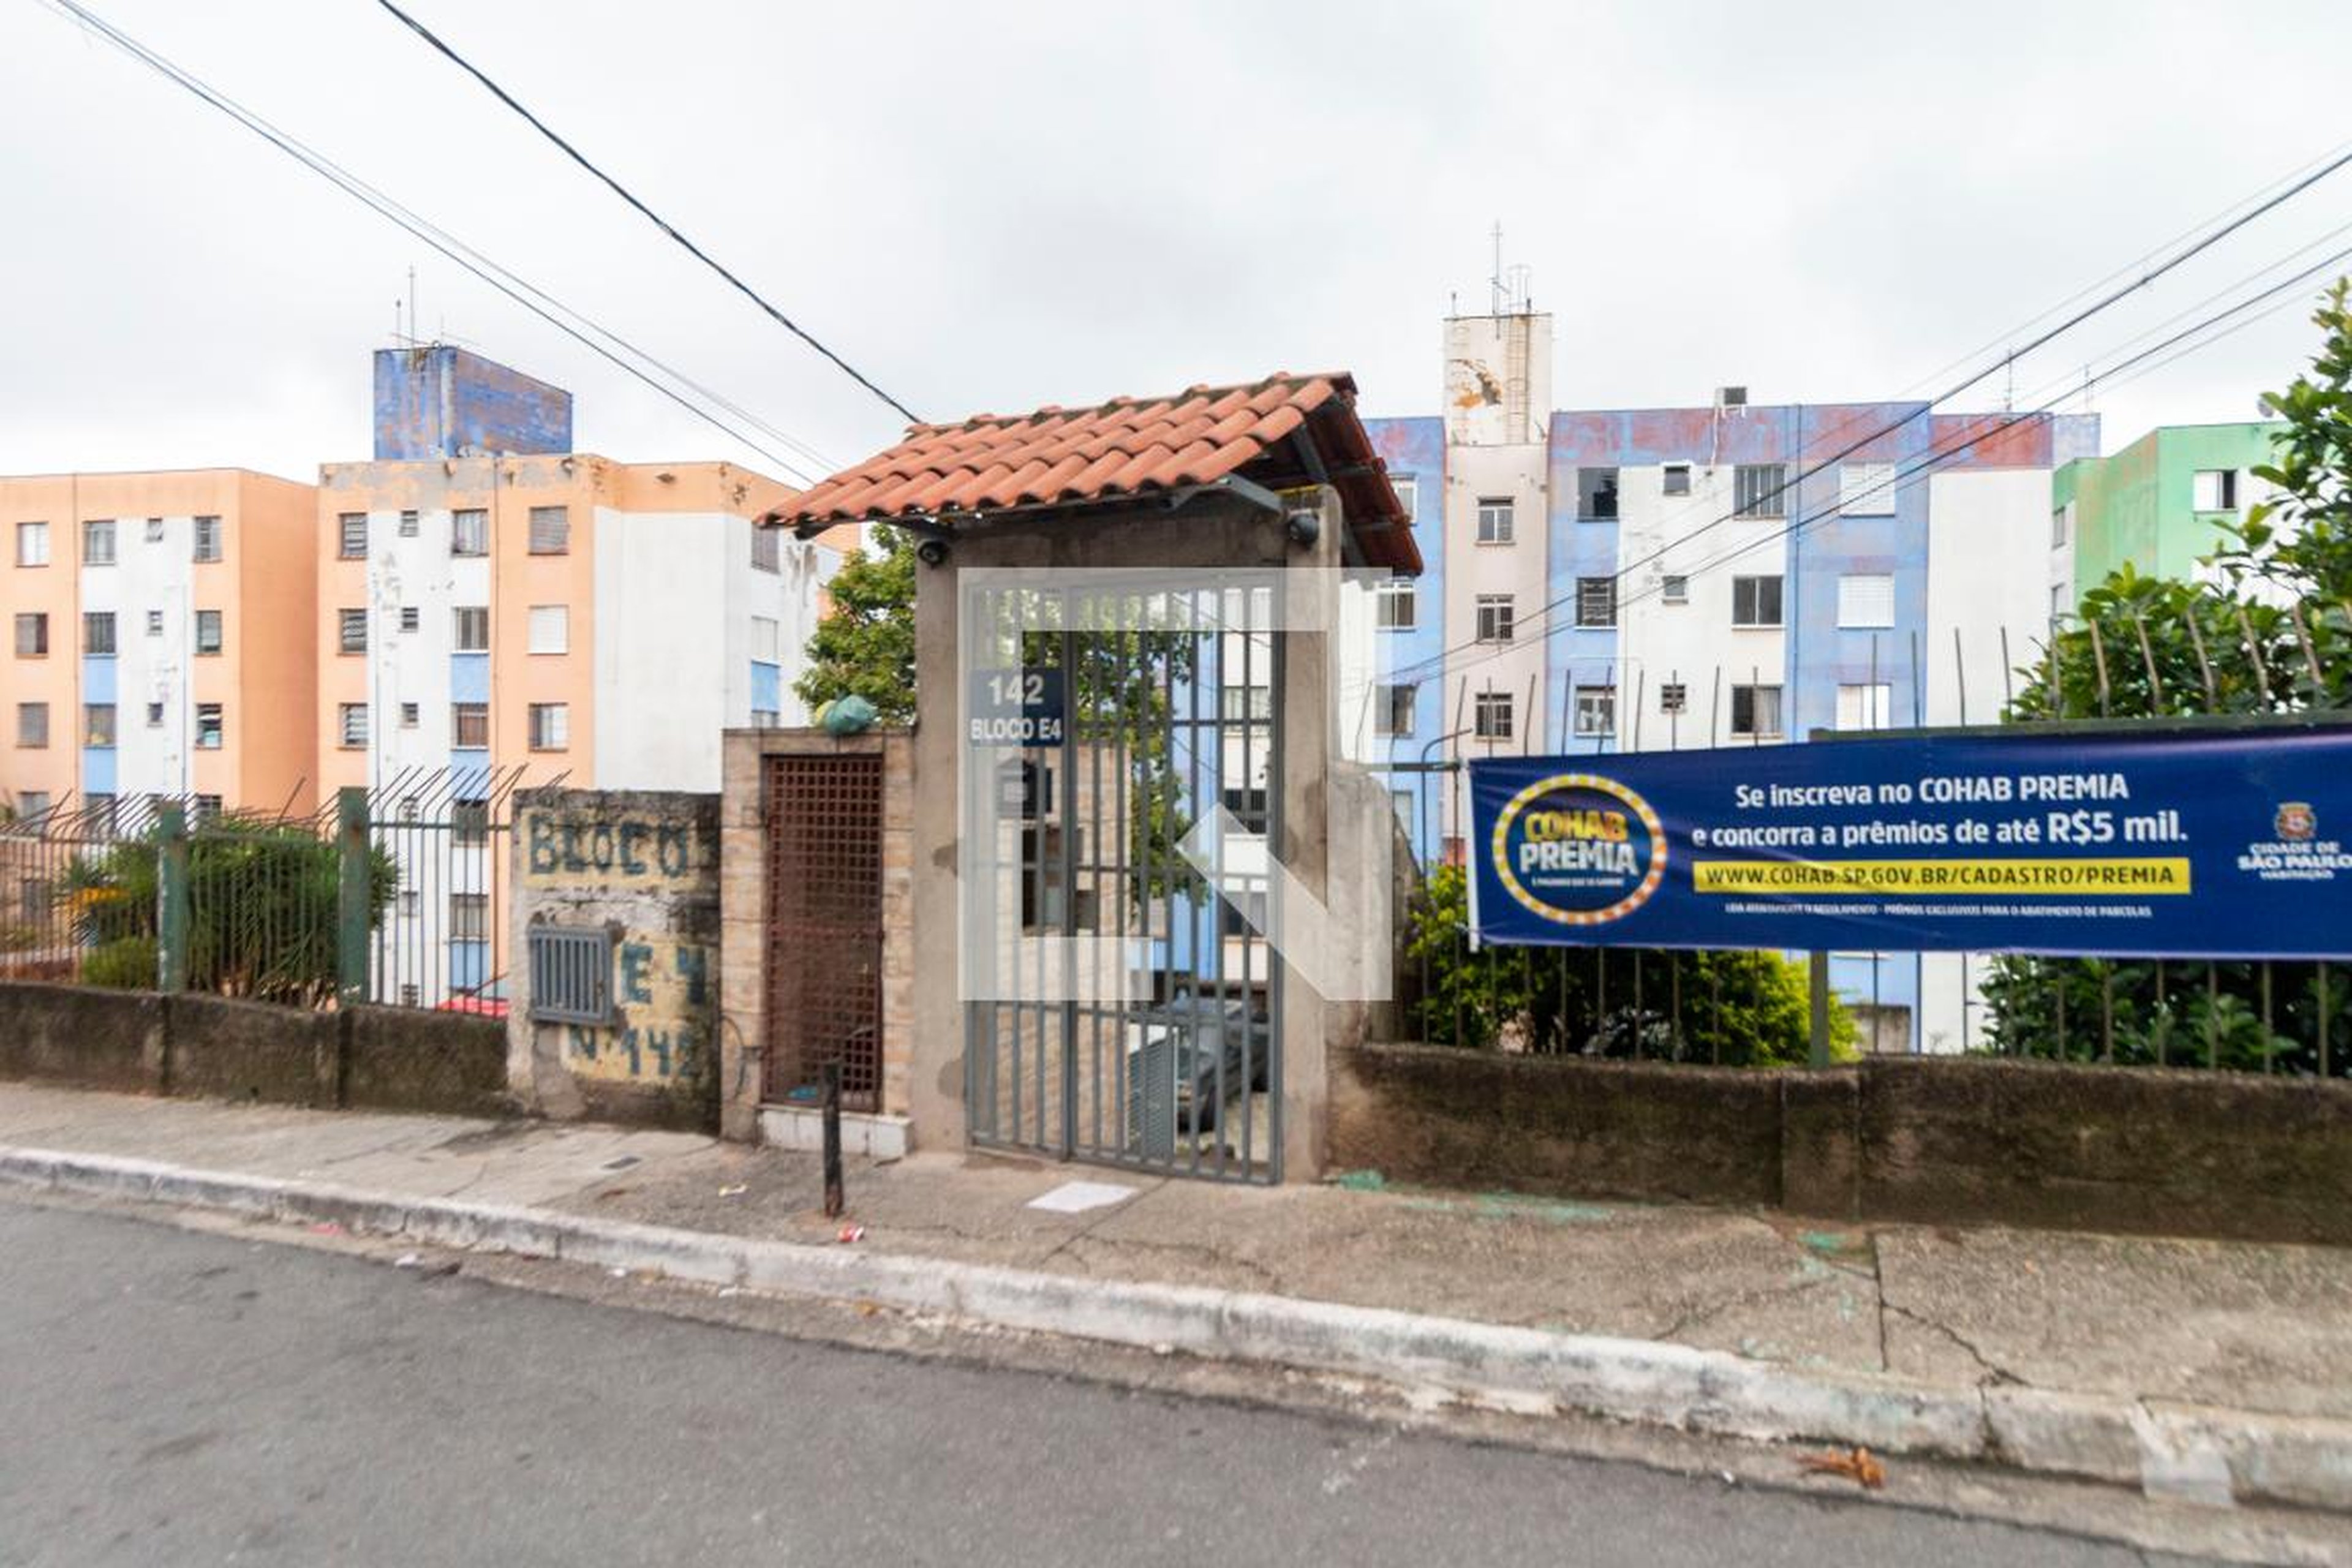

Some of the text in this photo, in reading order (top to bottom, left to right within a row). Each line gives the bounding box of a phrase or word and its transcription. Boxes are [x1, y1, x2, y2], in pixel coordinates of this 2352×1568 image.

[987, 674, 1044, 705] 142
[971, 718, 1062, 740] BLOCO E4
[1735, 773, 2130, 809] Se inscreva no COHAB PREMIA
[1525, 810, 1629, 843] COHAB
[1691, 809, 2189, 849] e concorra a prêmios de até R$5 mil.
[530, 813, 690, 878] BLOCO
[1519, 839, 1640, 877] PREMIA
[2249, 842, 2341, 854] CIDADE DE
[2285, 853, 2352, 869] PAULO
[1706, 865, 2174, 885] WWW.COHAB.SP.GOV.BR/CADASTRO/PREMIA
